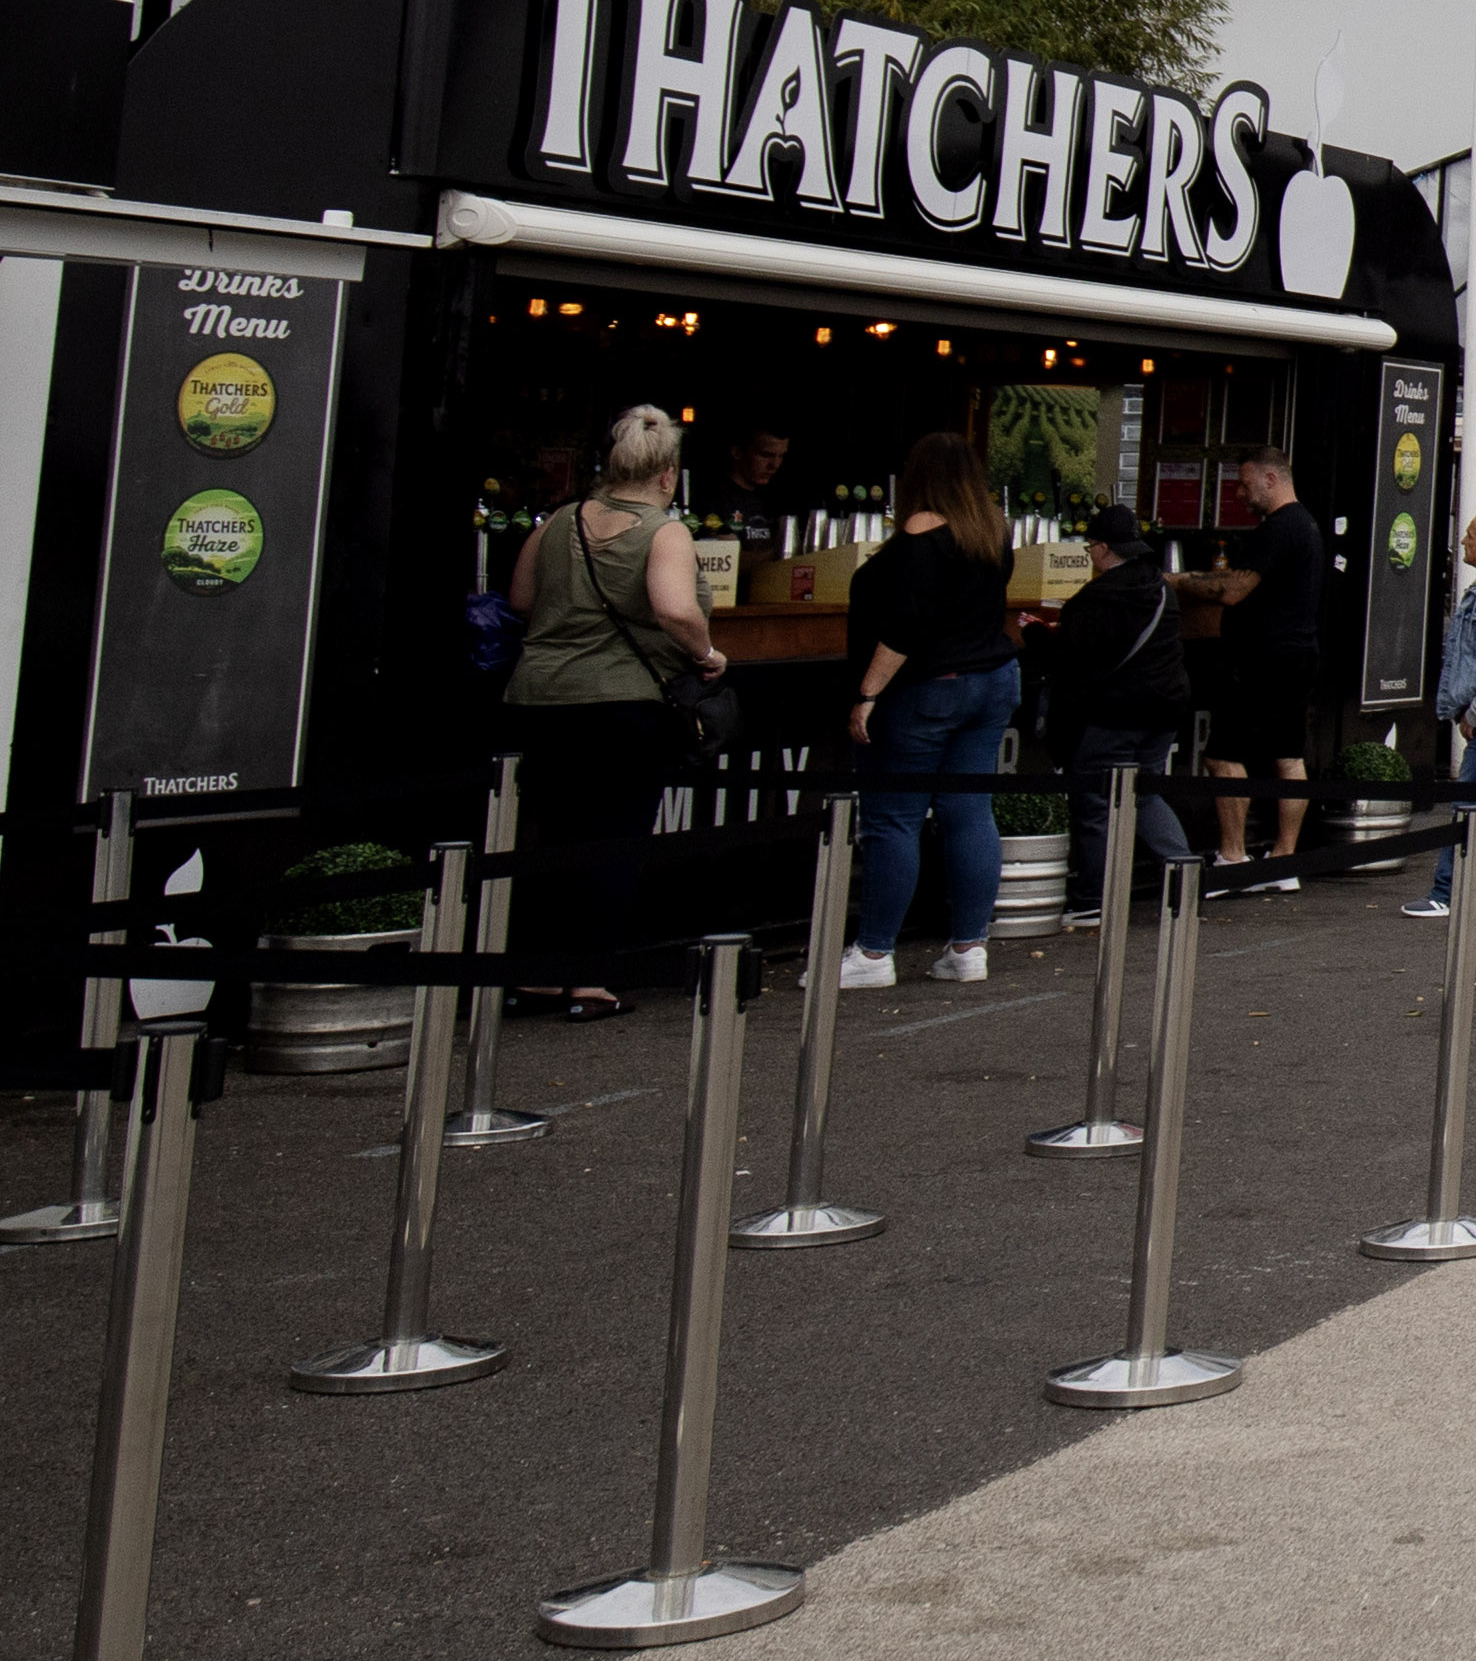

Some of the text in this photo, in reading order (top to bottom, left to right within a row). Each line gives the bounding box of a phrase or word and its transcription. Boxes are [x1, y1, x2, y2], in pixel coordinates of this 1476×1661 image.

[178, 269, 304, 300] Drinks
[184, 303, 291, 340] Menu
[191, 379, 269, 396] THATCHERS
[1393, 379, 1430, 400] Drinks
[205, 397, 250, 420] Gold
[1394, 404, 1425, 425] Menu
[177, 518, 256, 534] THATCHERS
[187, 534, 240, 553] Haze
[144, 773, 238, 796] THATCHERS
